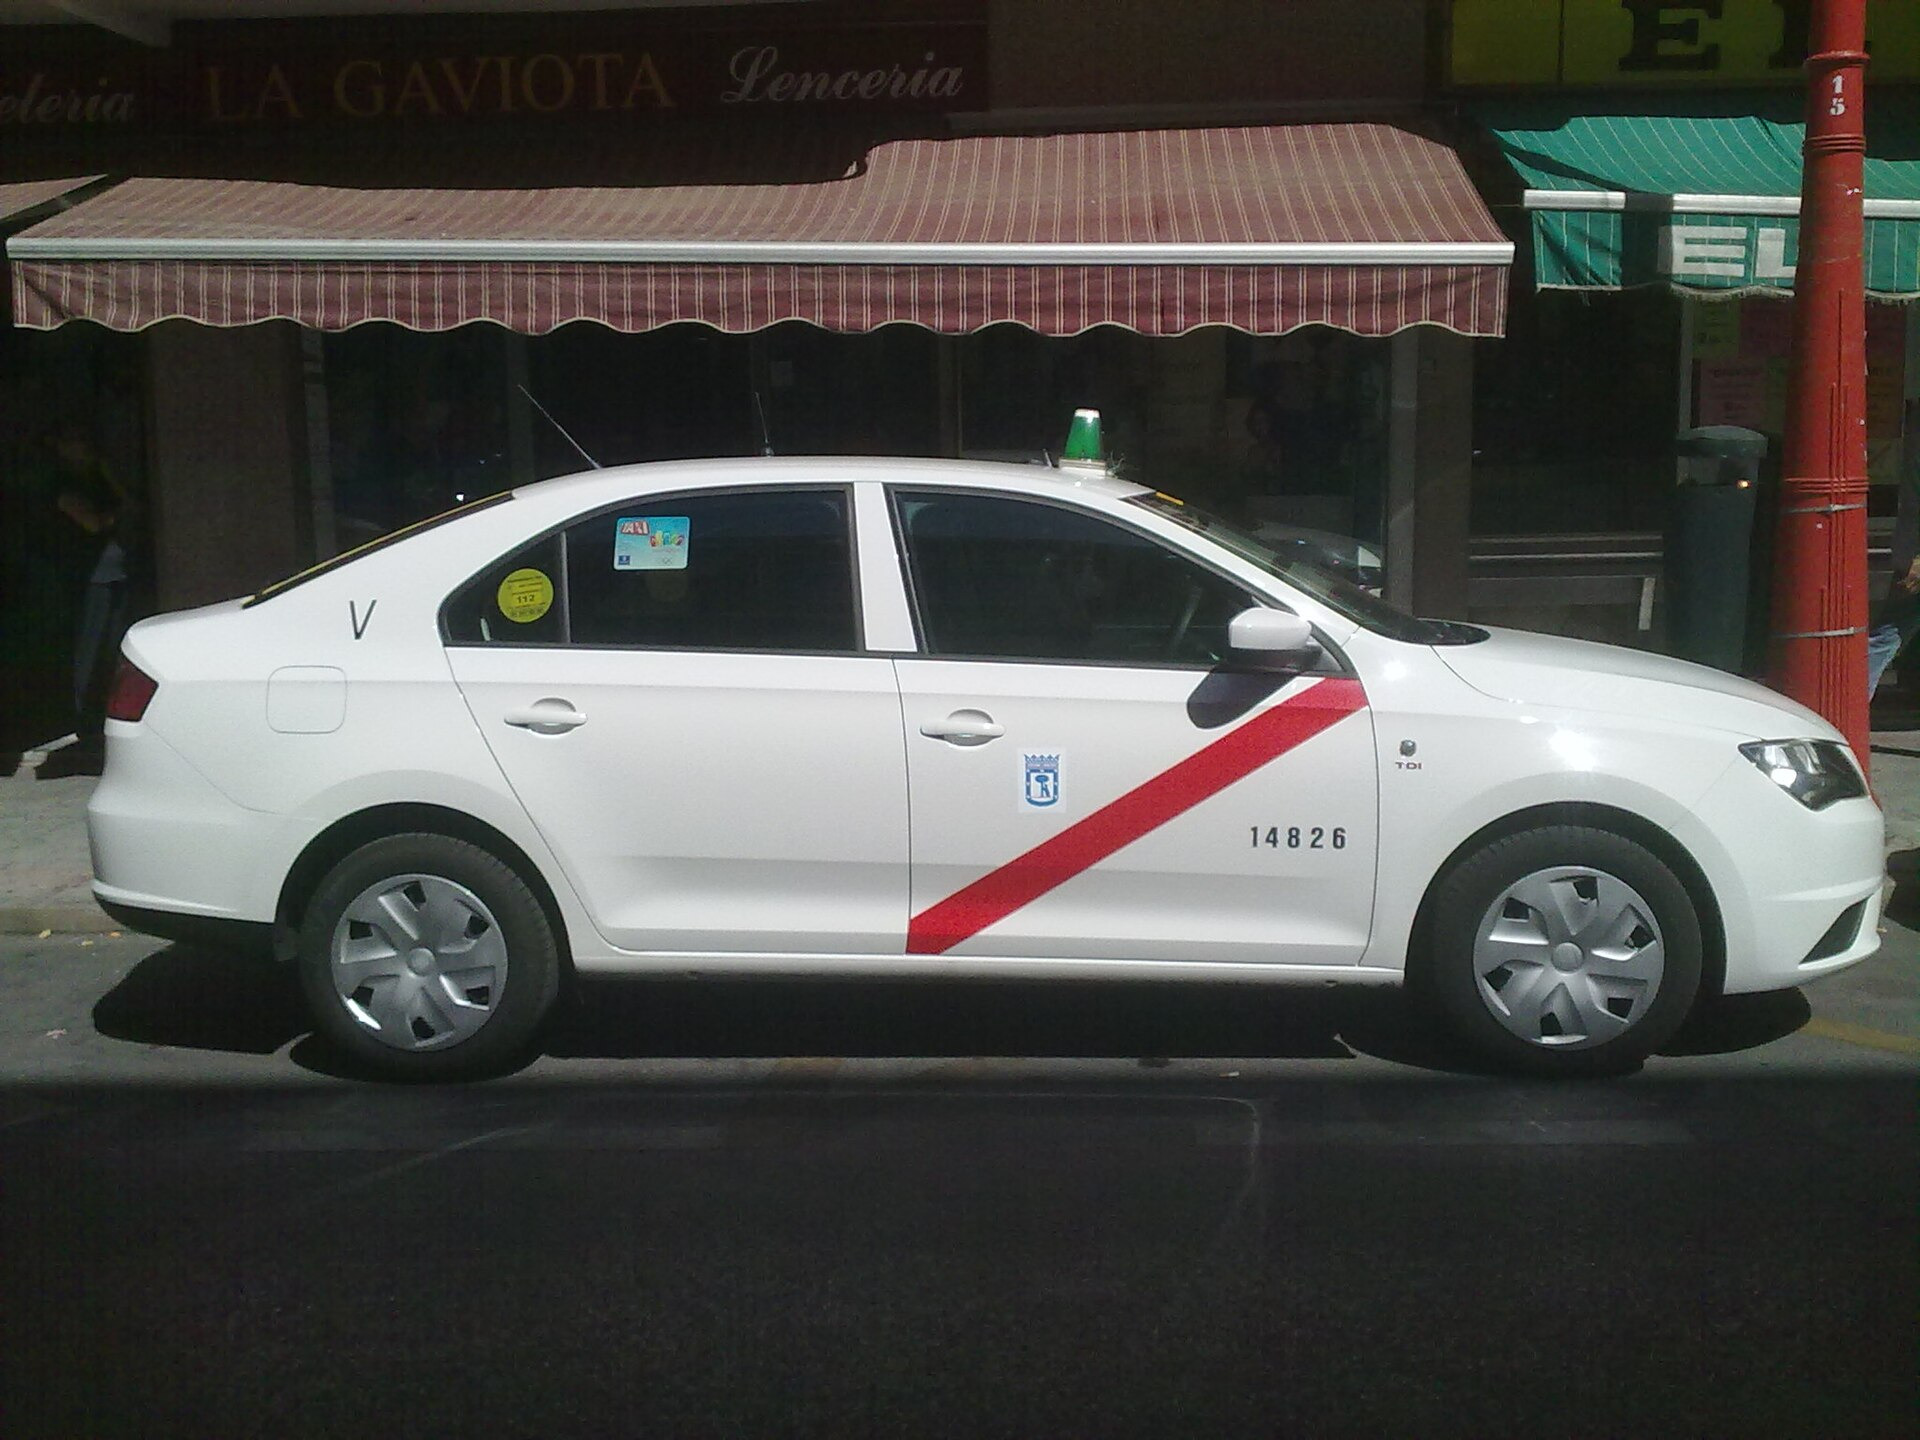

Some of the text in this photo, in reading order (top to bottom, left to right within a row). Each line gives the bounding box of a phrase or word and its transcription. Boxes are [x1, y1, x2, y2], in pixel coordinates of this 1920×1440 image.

[207, 53, 676, 122] LA GAVIOTA
[720, 45, 963, 103] Lenceria
[1395, 761, 1422, 770] TDI
[1250, 826, 1346, 850] 14826
